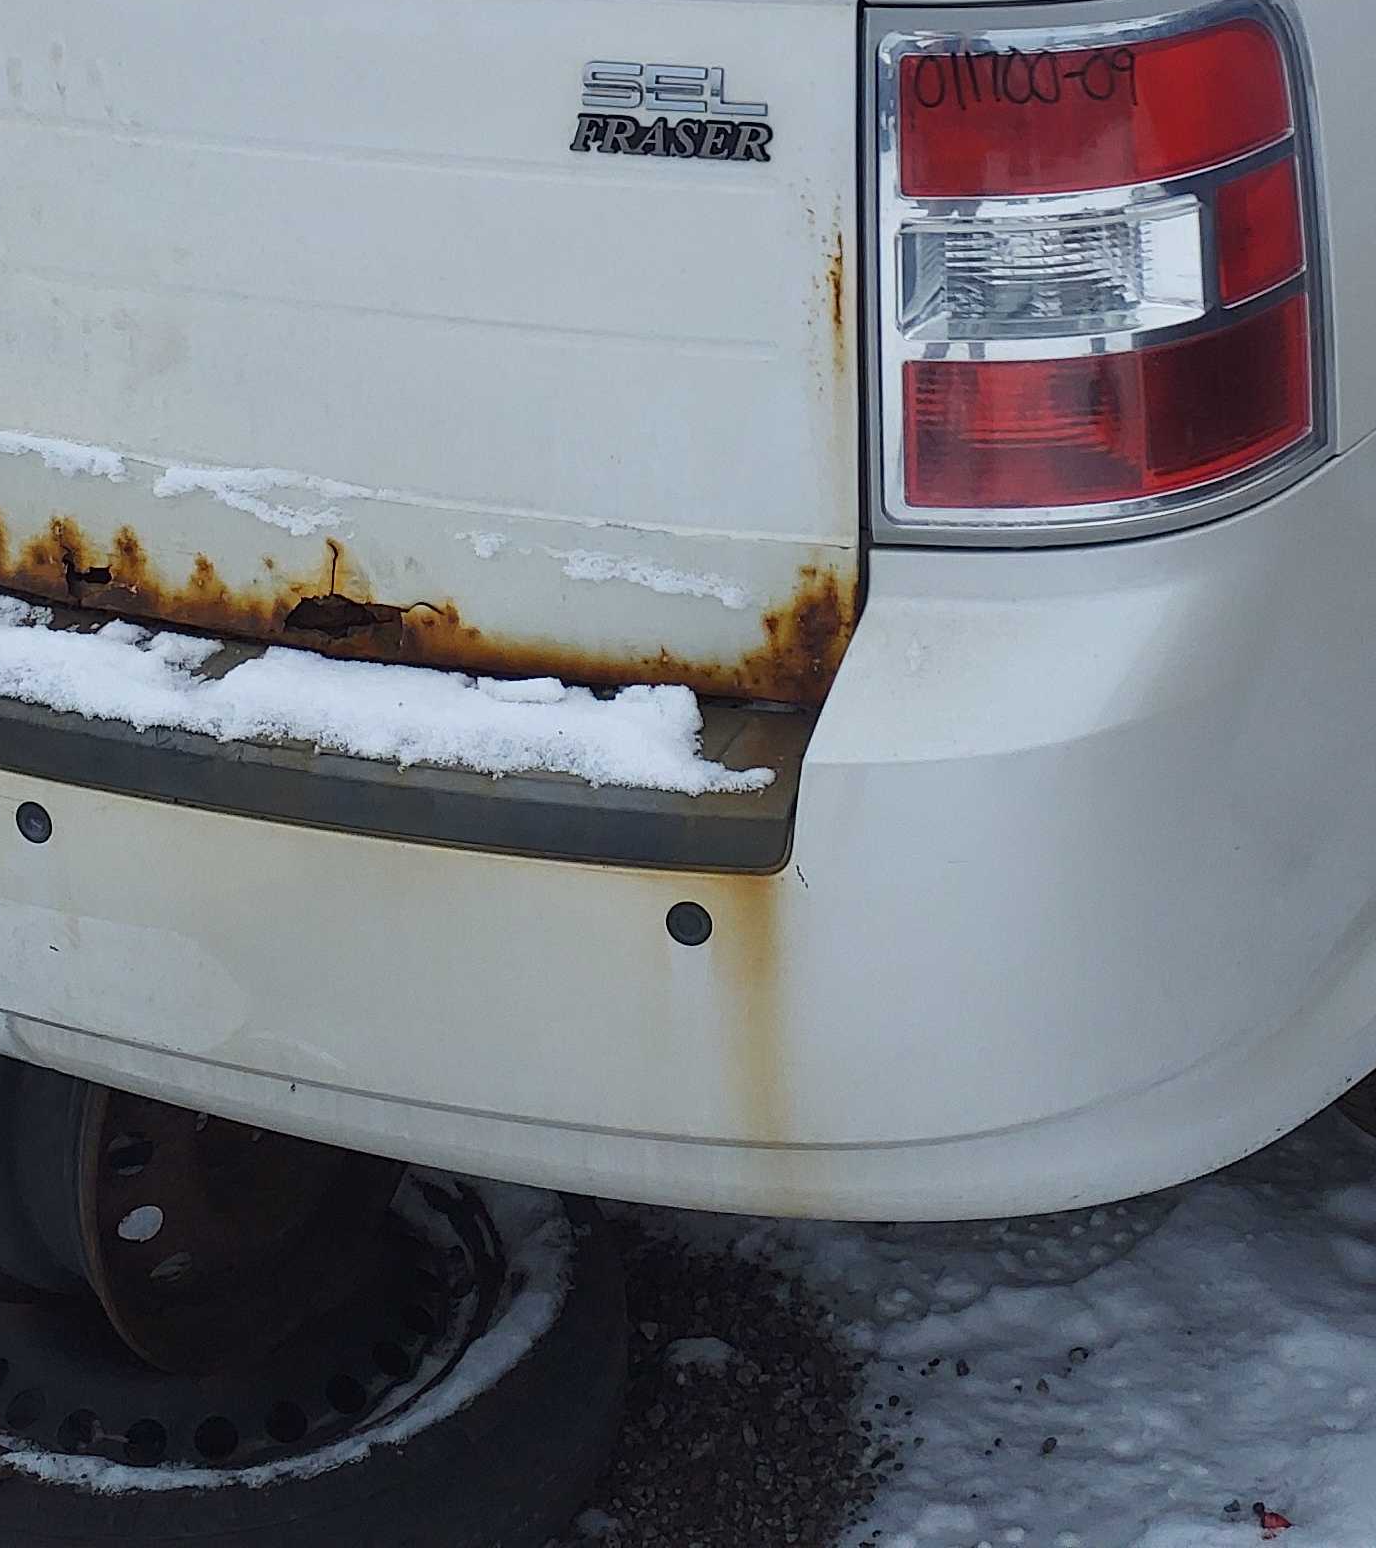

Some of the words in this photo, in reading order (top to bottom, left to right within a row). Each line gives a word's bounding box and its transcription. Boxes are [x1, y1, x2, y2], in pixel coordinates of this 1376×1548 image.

[581, 60, 769, 117] SEL
[914, 47, 1138, 110] 011700-09
[569, 113, 774, 163] FRASER
